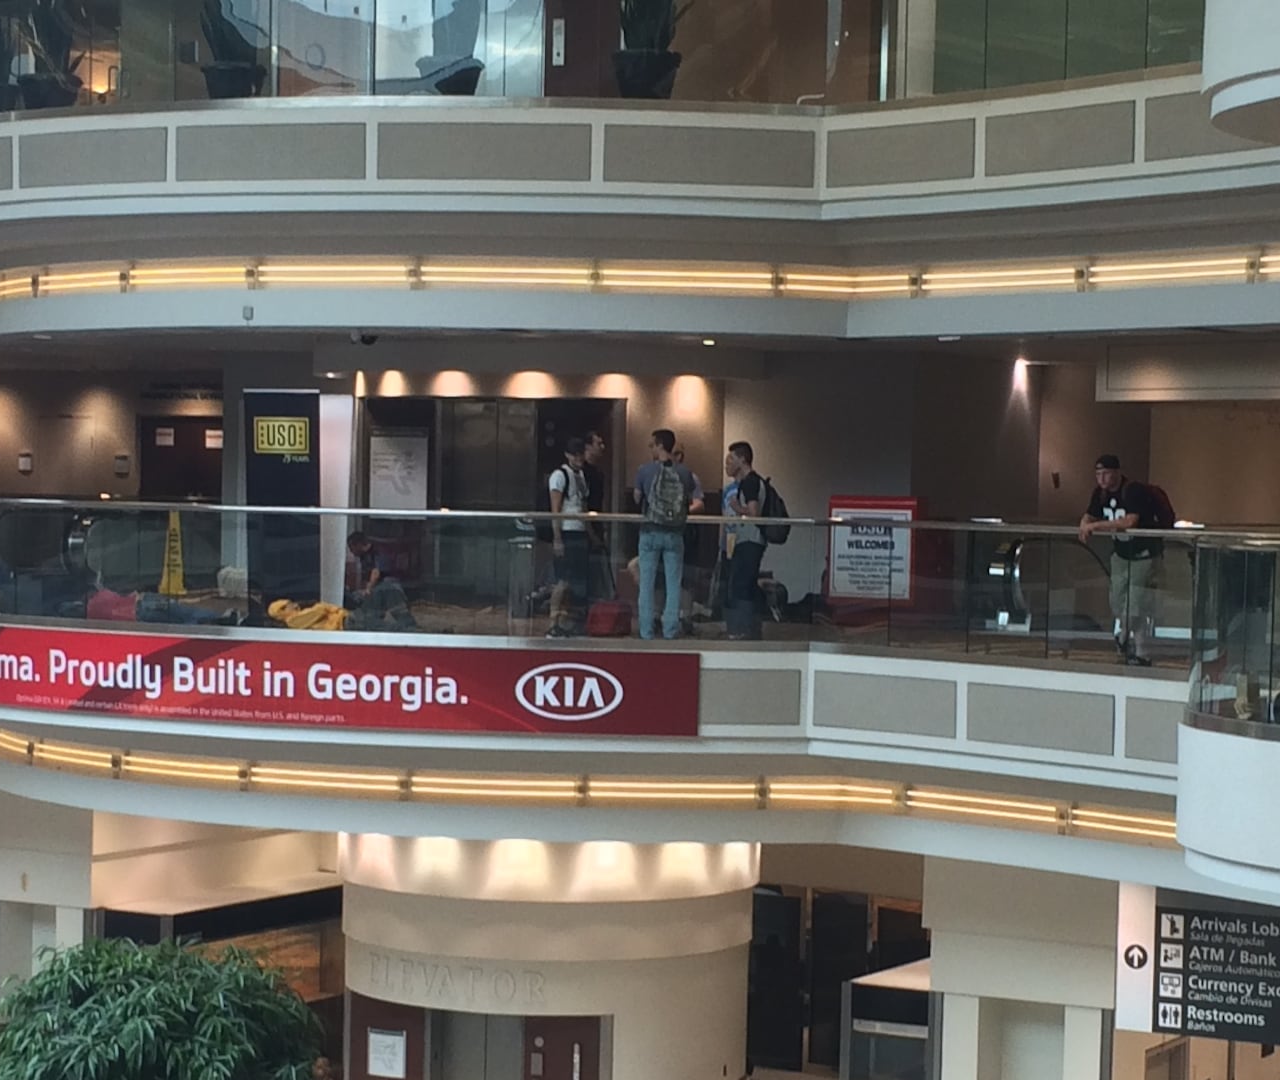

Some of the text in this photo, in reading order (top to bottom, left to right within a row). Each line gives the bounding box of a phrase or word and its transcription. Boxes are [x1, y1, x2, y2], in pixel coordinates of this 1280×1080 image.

[267, 424, 296, 447] USO
[49, 649, 162, 698] Proudly
[174, 656, 252, 696] Built
[263, 661, 294, 698] in
[308, 662, 469, 711] Georgia.
[534, 676, 605, 708] KIA
[1190, 916, 1247, 934] Arrivals
[1189, 946, 1277, 967] ATM / Bank
[370, 952, 546, 1001] ELEVATOR
[1188, 961, 1222, 974] Cajeros
[1188, 975, 1254, 997] Currency
[1187, 991, 1273, 1008] Cambio de Divisas
[1187, 1006, 1266, 1027] Restrooms
